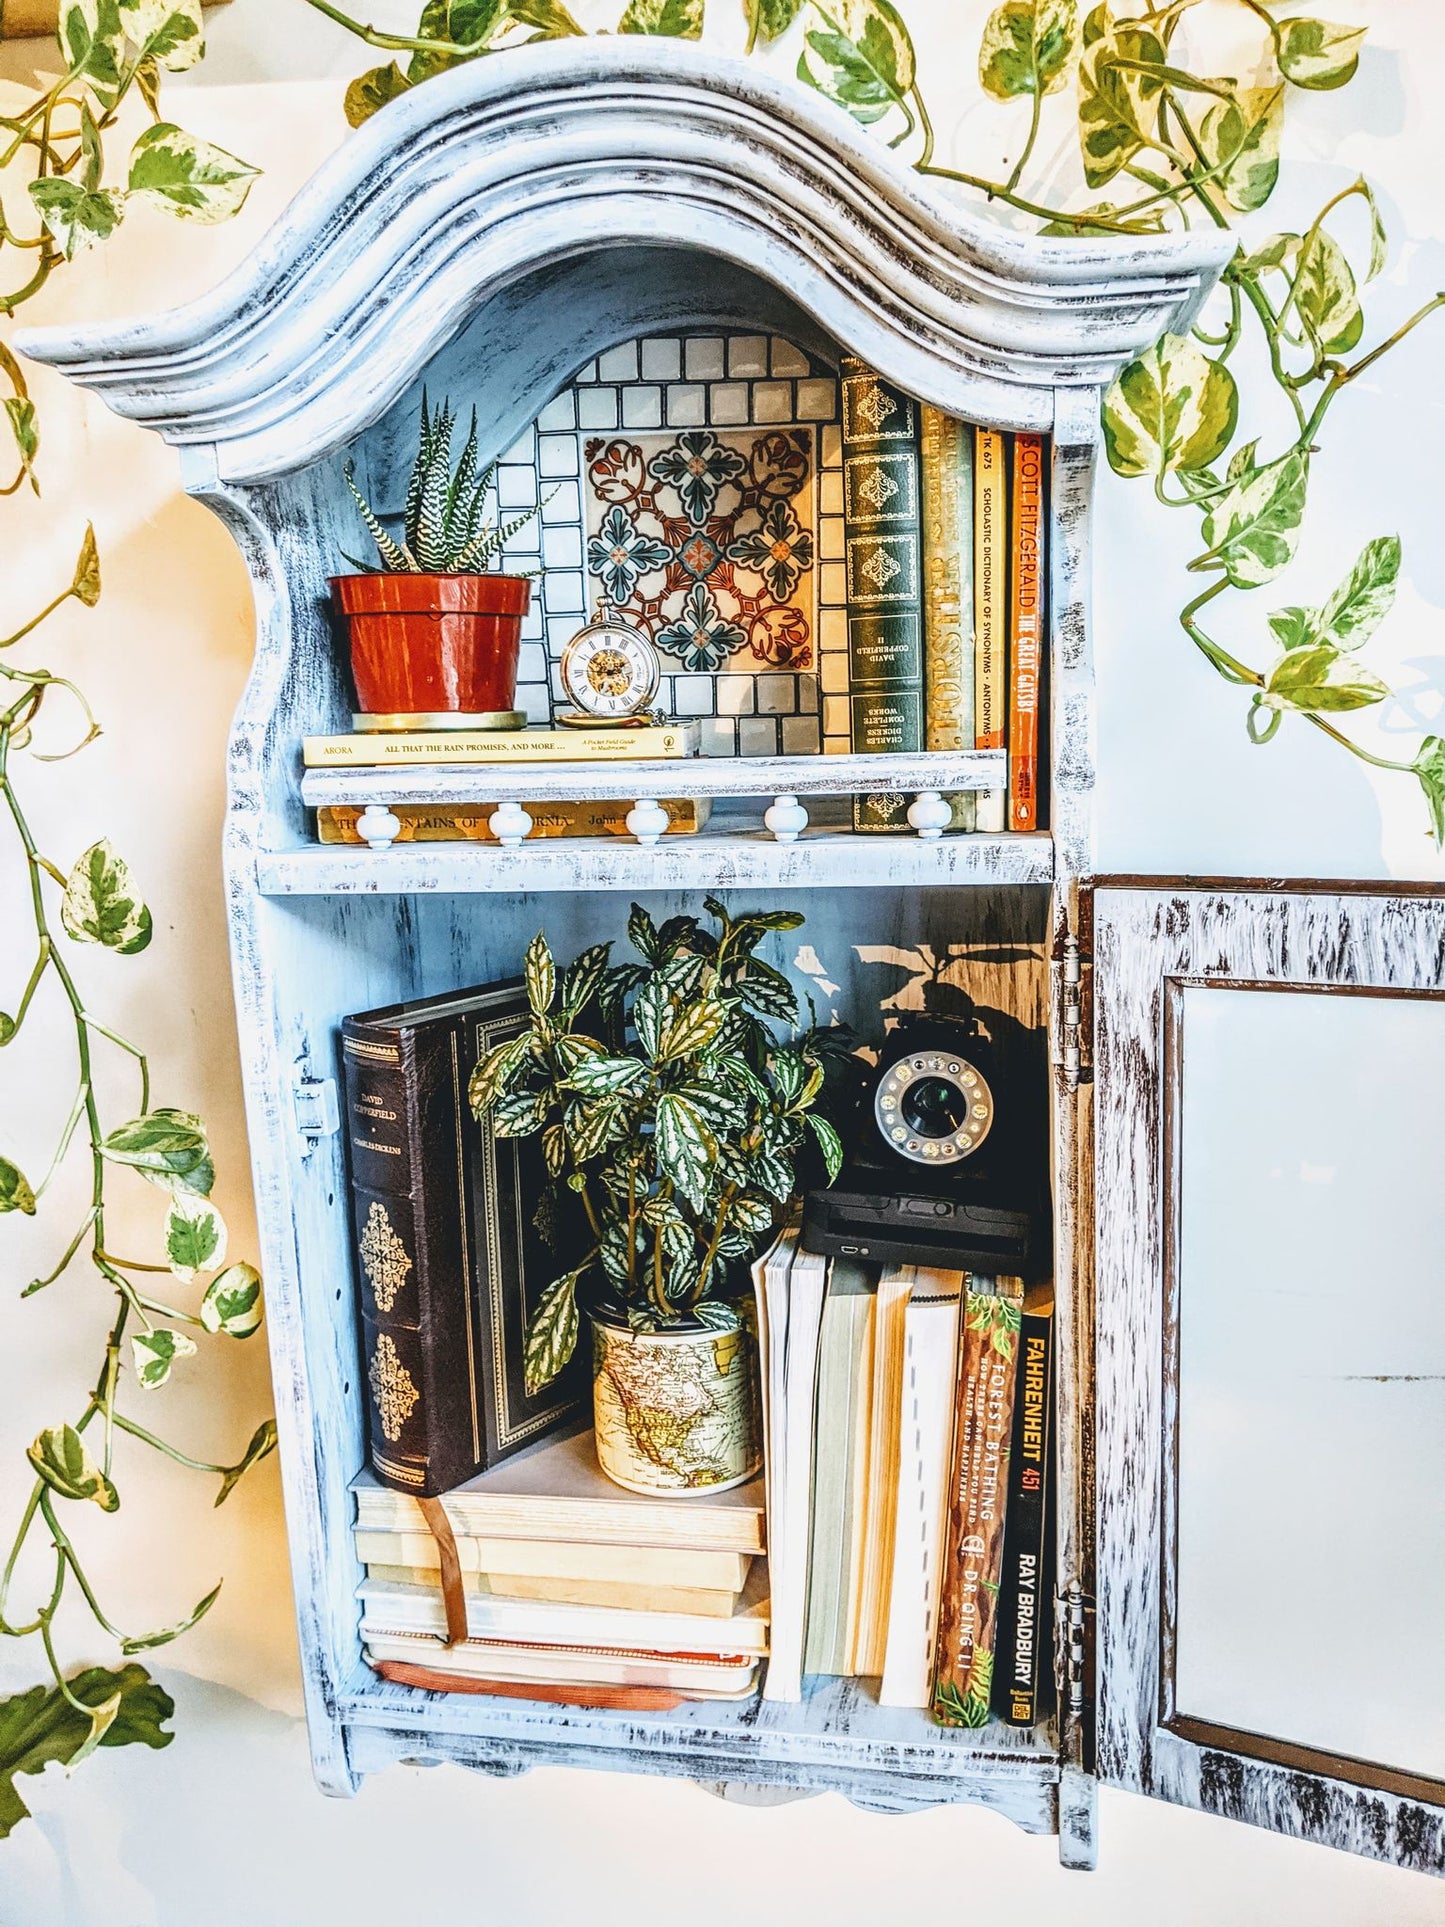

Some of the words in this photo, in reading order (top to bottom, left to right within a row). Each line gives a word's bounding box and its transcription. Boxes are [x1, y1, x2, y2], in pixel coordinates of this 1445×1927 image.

[983, 437, 992, 449] TK
[983, 452, 992, 470] 675
[1020, 438, 1039, 496] SCOTT
[983, 487, 992, 543] SCHOLASTIC
[1019, 504, 1038, 608] FITZGERALD
[983, 546, 992, 603] DICTIONARY
[983, 606, 992, 619] OF
[1018, 613, 1036, 633] THE
[856, 644, 909, 655] COPPERFIELD
[930, 551, 963, 733] FORSTER
[983, 622, 992, 674] SYNONYMS
[1017, 636, 1036, 670] GREAT
[869, 654, 895, 662] DAVID
[1016, 673, 1035, 713] GATSBY
[863, 715, 905, 725] COMPLETE
[868, 708, 898, 716] WORKS
[983, 683, 992, 735] ANTONYMS
[866, 727, 902, 736] DICKENS
[866, 736, 903, 745] CHARLES
[385, 745, 400, 753] ALL
[401, 745, 423, 753] THAT
[444, 744, 464, 752] RAIN
[466, 743, 510, 752] PROMISES,
[338, 819, 358, 830] TH
[401, 817, 456, 829] NTAINS
[462, 816, 479, 828] OF
[588, 814, 616, 826] John
[361, 1093, 383, 1105] DAVID
[980, 1357, 989, 1381] HOW
[965, 1375, 977, 1417] HEALTH
[976, 1383, 987, 1418] TREES
[987, 1363, 1006, 1433] FOREST
[1022, 1337, 1045, 1462] FAHRENHEIT
[963, 1419, 972, 1442] AND
[974, 1420, 983, 1443] CAN
[972, 1445, 982, 1471] HELP
[959, 1444, 971, 1503] HAPPINESS
[970, 1472, 980, 1495] YOU
[980, 1441, 1000, 1521] BATHING
[1021, 1467, 1041, 1492] 451
[967, 1497, 978, 1524] FIND
[962, 1570, 979, 1596] DR.
[1018, 1553, 1037, 1590] RAY
[958, 1602, 976, 1647] QING
[1014, 1593, 1035, 1686] BRADBURY
[956, 1652, 972, 1669] LI
